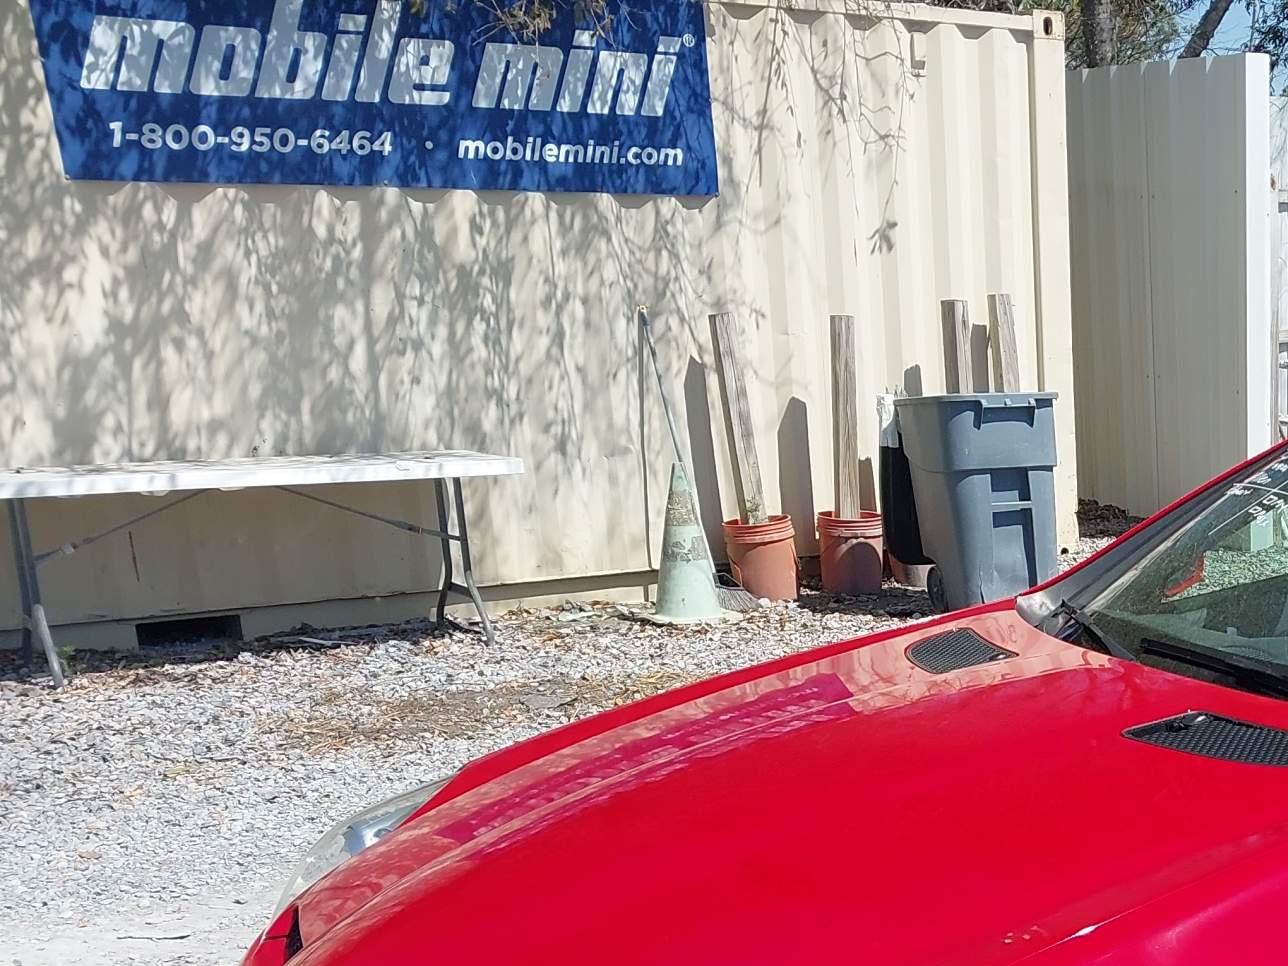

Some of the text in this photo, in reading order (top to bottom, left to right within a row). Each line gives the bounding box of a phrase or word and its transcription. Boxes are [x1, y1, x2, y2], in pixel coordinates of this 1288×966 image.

[80, 0, 456, 106] mobile
[108, 121, 684, 167] 1-800-950-6464 mobilemini.com
